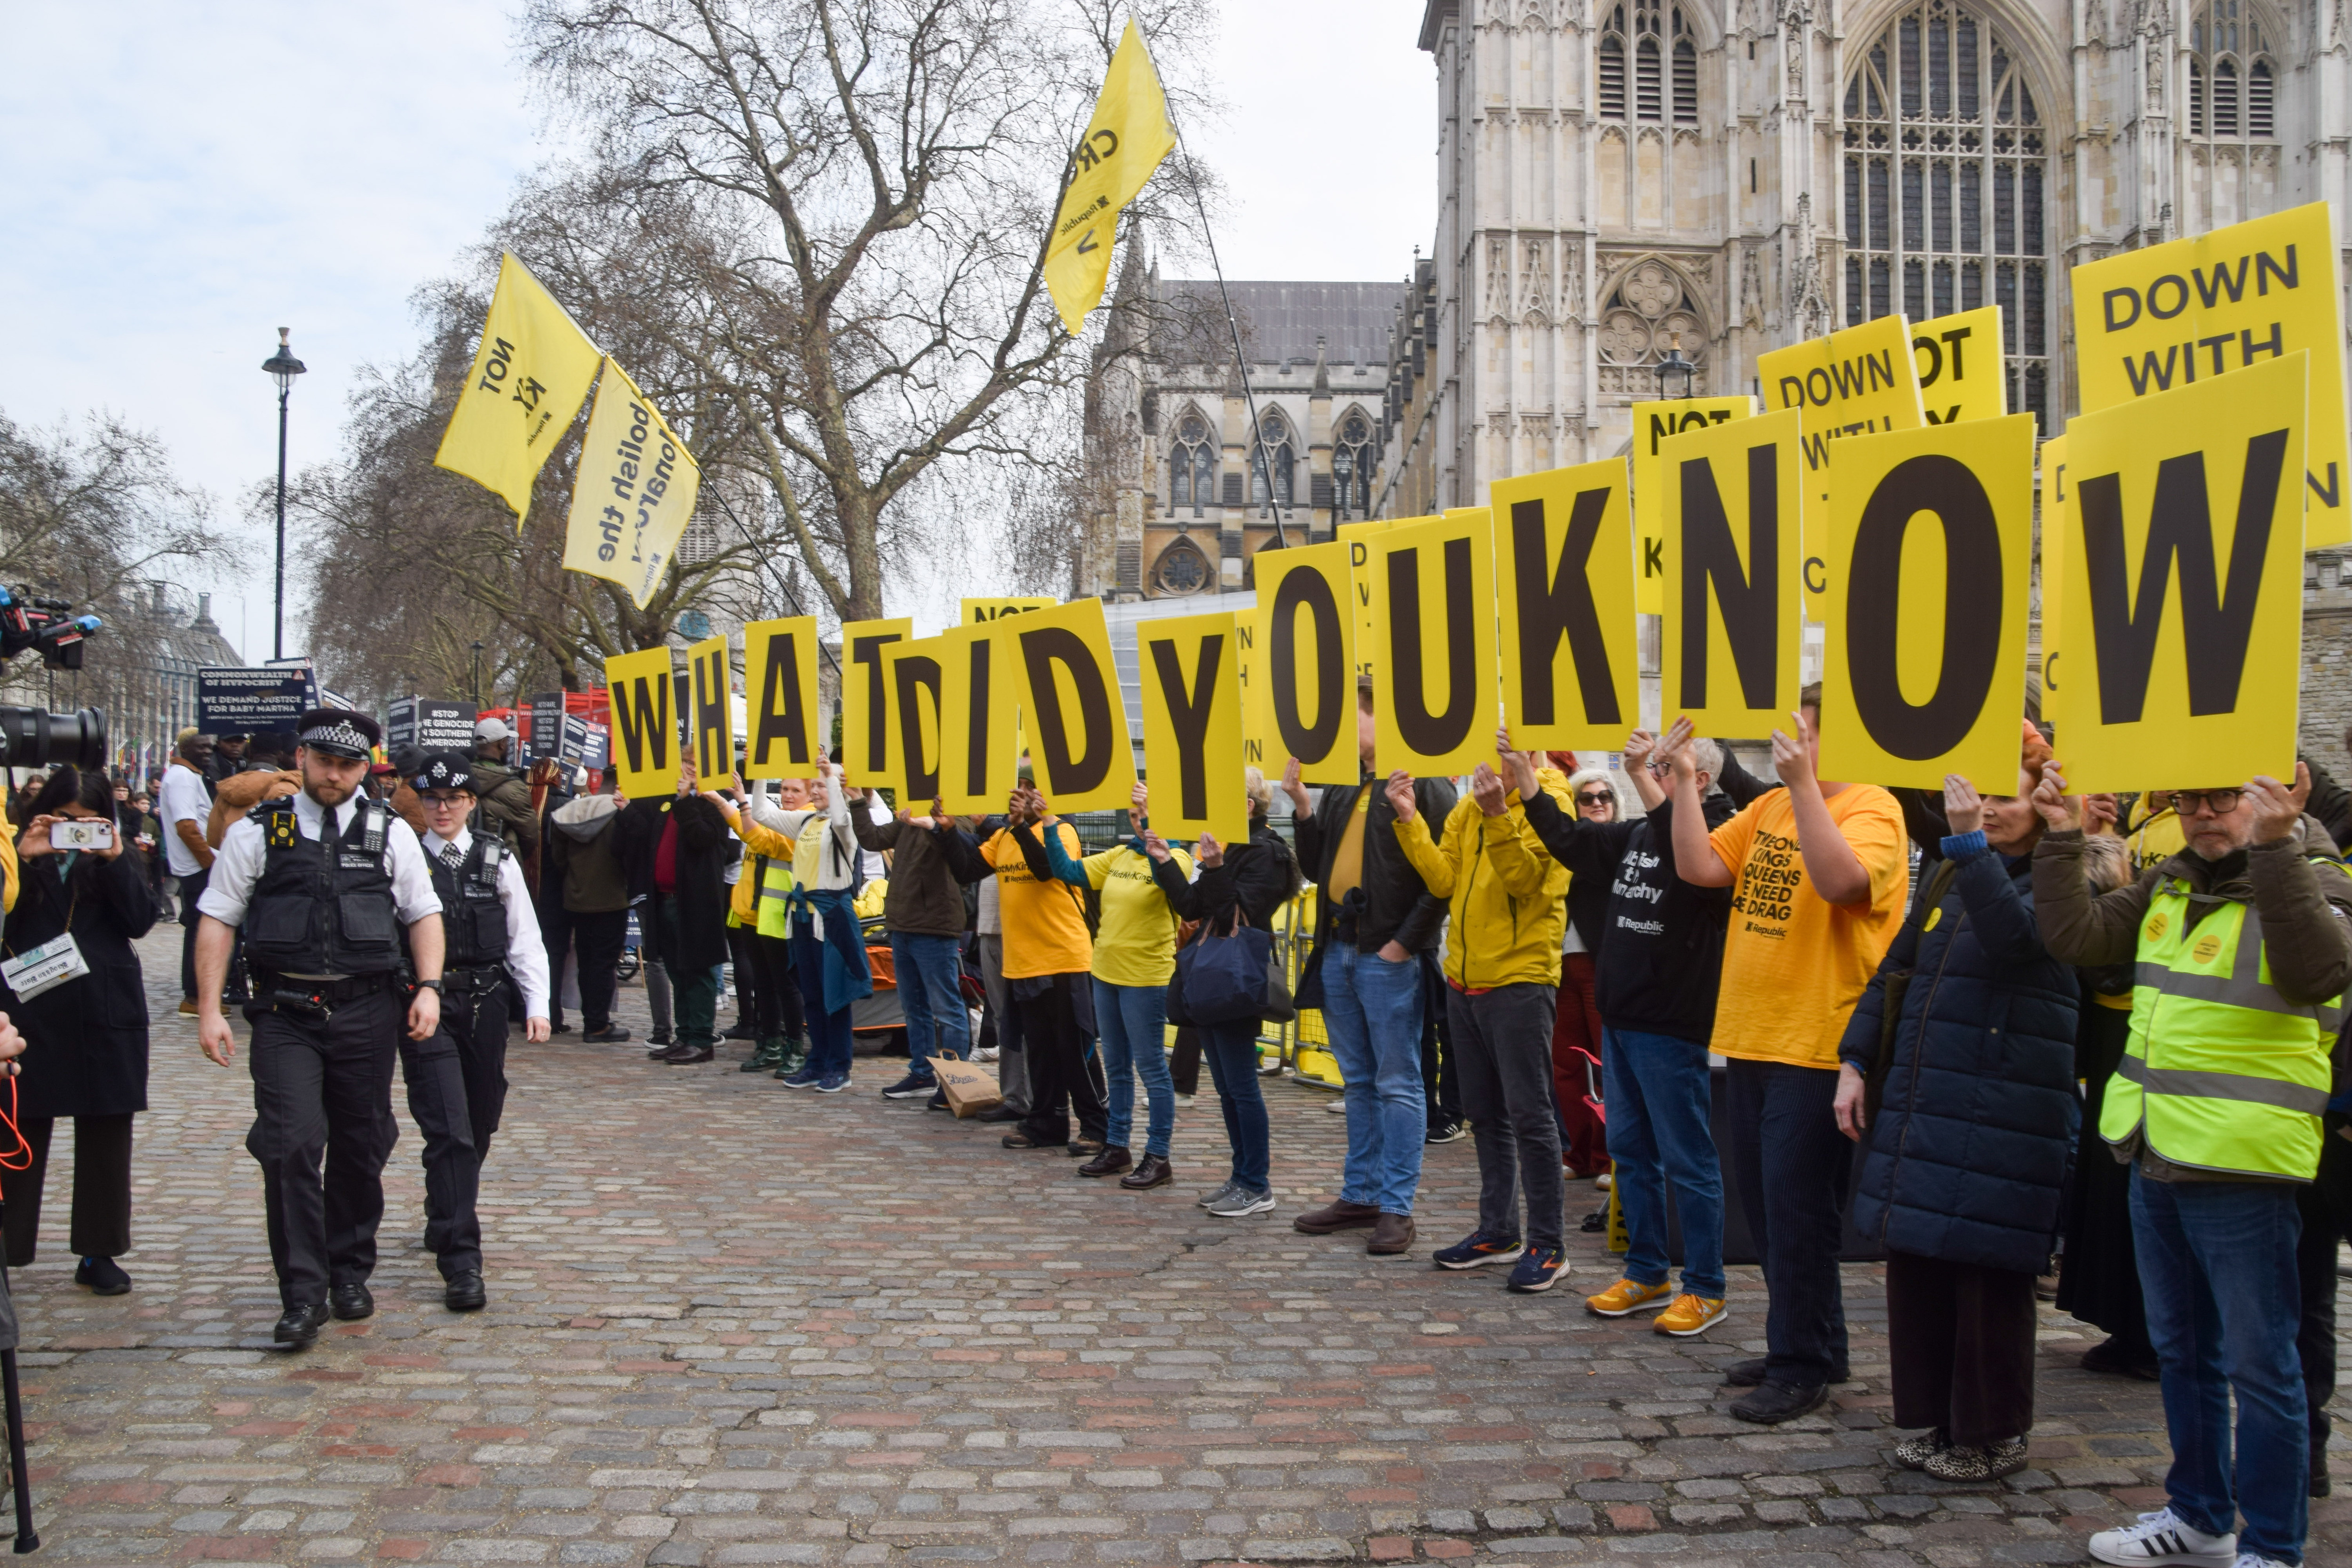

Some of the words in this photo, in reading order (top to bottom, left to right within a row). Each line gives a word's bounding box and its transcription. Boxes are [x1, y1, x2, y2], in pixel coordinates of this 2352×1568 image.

[2103, 244, 2299, 333] DOWN
[1780, 349, 1895, 409] DOWN
[1511, 487, 1622, 725] K
[1681, 443, 1778, 709] N
[1847, 455, 2002, 761] O
[2078, 428, 2289, 725] W
[755, 633, 809, 764] A
[854, 634, 886, 772] T
[1019, 628, 1112, 796] D
[1271, 565, 1344, 765] O
[1388, 537, 1476, 756] U
[431, 709, 459, 718] #STOP
[432, 719, 475, 728] GENOCIDE
[612, 673, 667, 773] W
[695, 651, 728, 778] H
[894, 656, 941, 801] D
[968, 639, 990, 796] I
[1149, 634, 1224, 820] Y
[1625, 918, 1665, 931] Republic
[1744, 863, 1802, 886] QUEENS
[1747, 900, 1792, 921] DRAG
[1752, 882, 1792, 903] NEED
[1753, 923, 1788, 937] Republic
